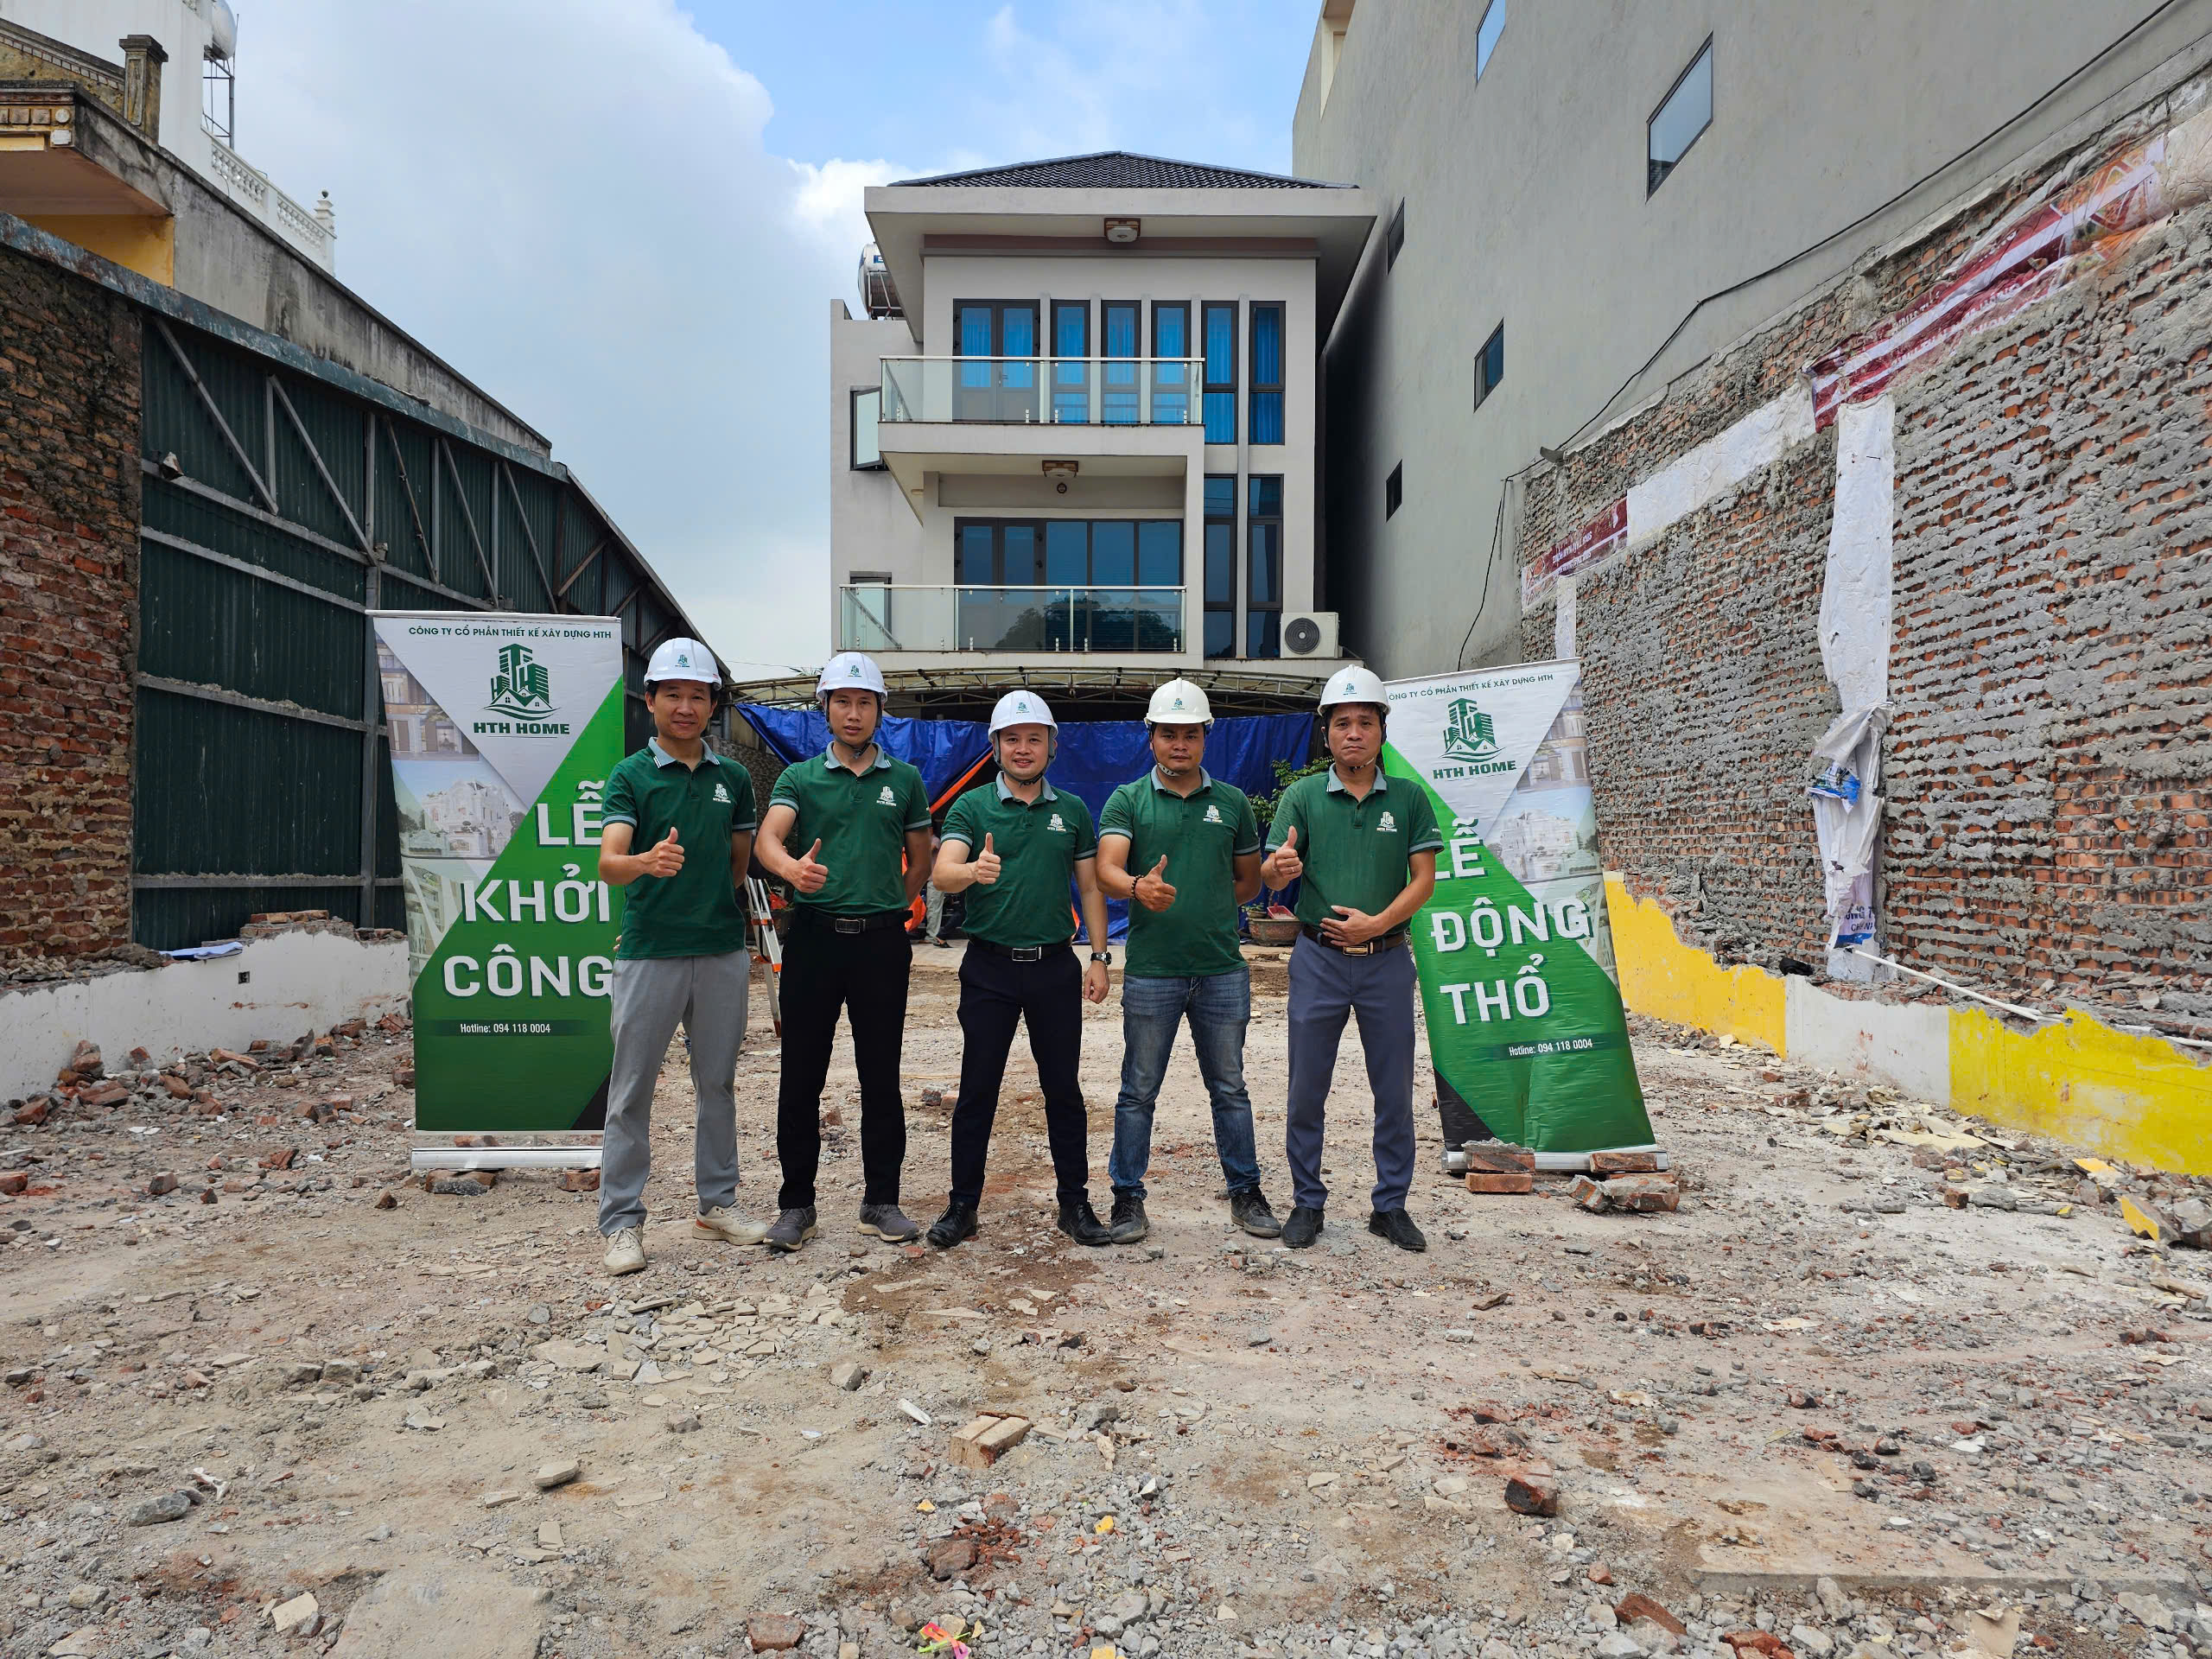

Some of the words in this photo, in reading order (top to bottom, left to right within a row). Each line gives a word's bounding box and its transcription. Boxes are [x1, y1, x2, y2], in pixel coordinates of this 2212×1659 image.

[409, 626, 438, 635] CÔNG
[454, 624, 470, 635] CỔ
[473, 626, 499, 636] PHẦN
[501, 626, 525, 637] THIẾT
[528, 626, 540, 637] KẾ
[542, 628, 561, 638] XÂY
[563, 629, 591, 639] DỰNG
[1389, 692, 1408, 701] ÔNG
[1420, 686, 1433, 696] CỔ
[1435, 684, 1458, 695] PHẦN
[1459, 681, 1479, 692] THIẾT
[1481, 679, 1491, 690] KẾ
[1493, 679, 1510, 688] XÂY
[1512, 676, 1535, 686] DỰNG
[473, 722, 511, 734] HTH
[516, 722, 570, 734] HOME
[1433, 766, 1465, 779] HTH
[1468, 760, 1517, 776] HOME
[537, 780, 605, 846] LỄ
[461, 863, 610, 923] KHỞI
[1430, 896, 1592, 957] ĐỘNG
[443, 944, 613, 997] CÔNG
[1440, 953, 1550, 1025] THỔ
[460, 1023, 492, 1033] Hotline:
[493, 1023, 510, 1033] 094
[512, 1023, 528, 1033] 118
[530, 1023, 551, 1033] 0004
[1509, 1045, 1536, 1056] Hotline:
[1537, 1042, 1554, 1053] 094
[1555, 1040, 1571, 1052] 118
[1573, 1038, 1593, 1050] 0004
